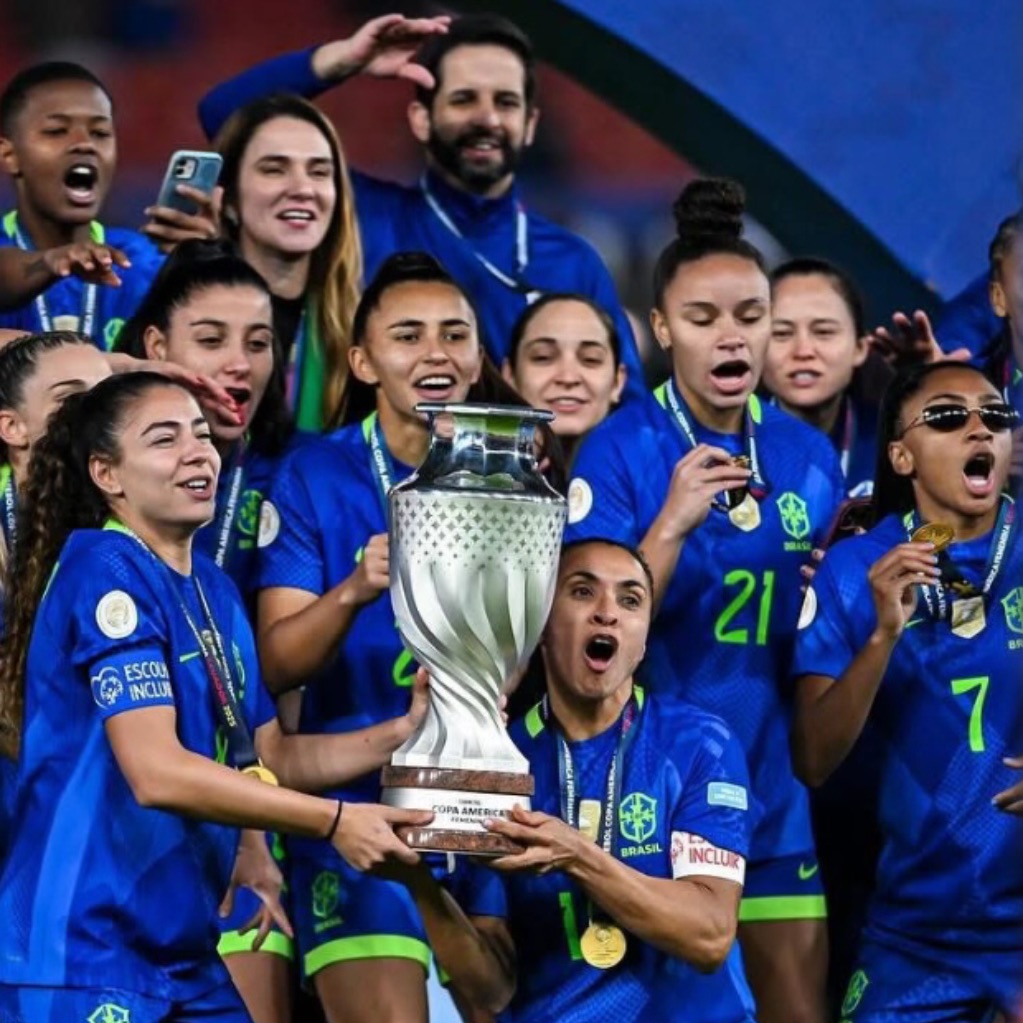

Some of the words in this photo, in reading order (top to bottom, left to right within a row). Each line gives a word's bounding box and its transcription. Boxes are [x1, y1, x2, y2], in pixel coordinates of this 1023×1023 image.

[714, 570, 775, 646] 21
[951, 676, 989, 752] 7
[432, 804, 459, 815] COPA
[621, 843, 662, 858] BRASIL
